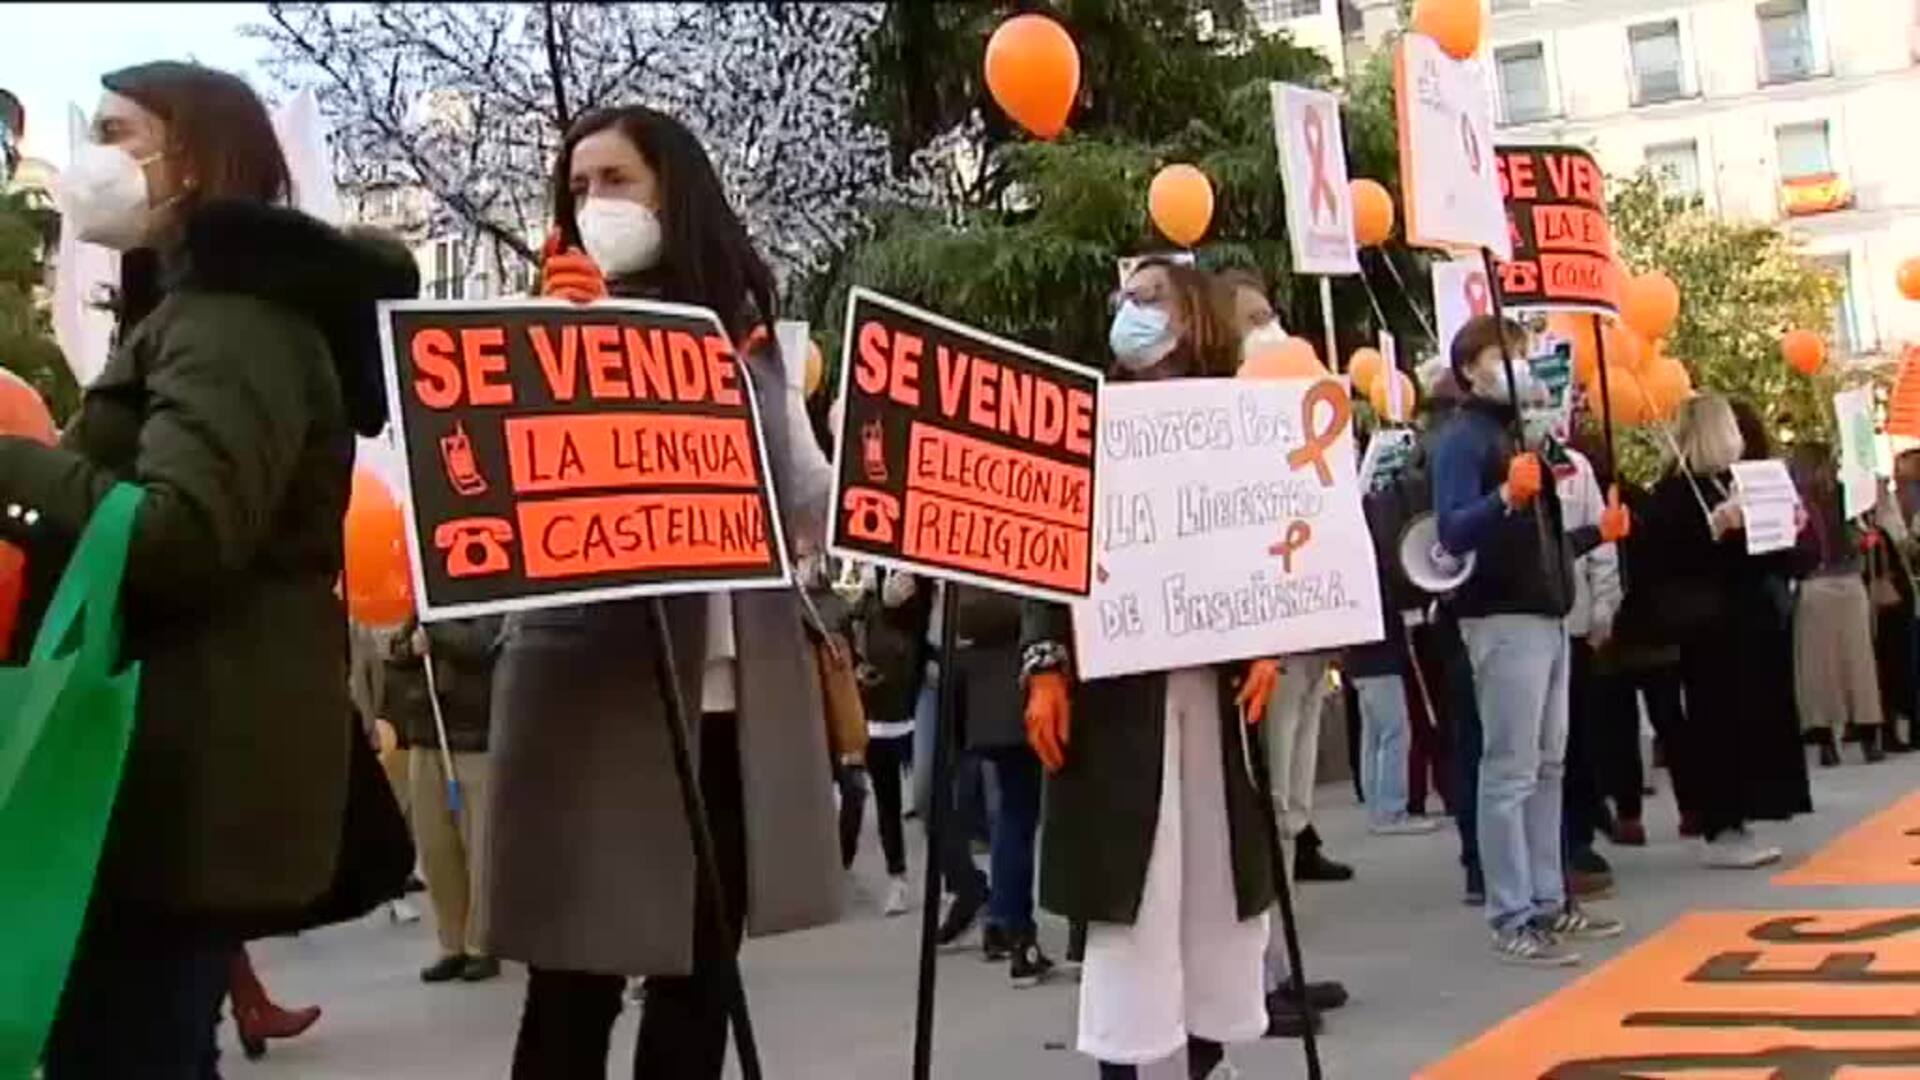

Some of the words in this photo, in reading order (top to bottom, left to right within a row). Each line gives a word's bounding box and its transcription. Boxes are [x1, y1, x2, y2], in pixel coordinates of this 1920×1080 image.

[1545, 211, 1575, 242] LA
[412, 328, 514, 408] SE
[528, 324, 742, 406] VENDE
[855, 321, 923, 406] SE
[937, 345, 1094, 456] VENDE
[528, 429, 585, 481] LA
[612, 426, 746, 478] LENGUA
[1061, 474, 1085, 515] DE
[1104, 493, 1156, 551] LA
[541, 496, 766, 562] CASTELLANA
[916, 502, 1070, 572] RELIGIÓN
[1100, 592, 1144, 641] DE
